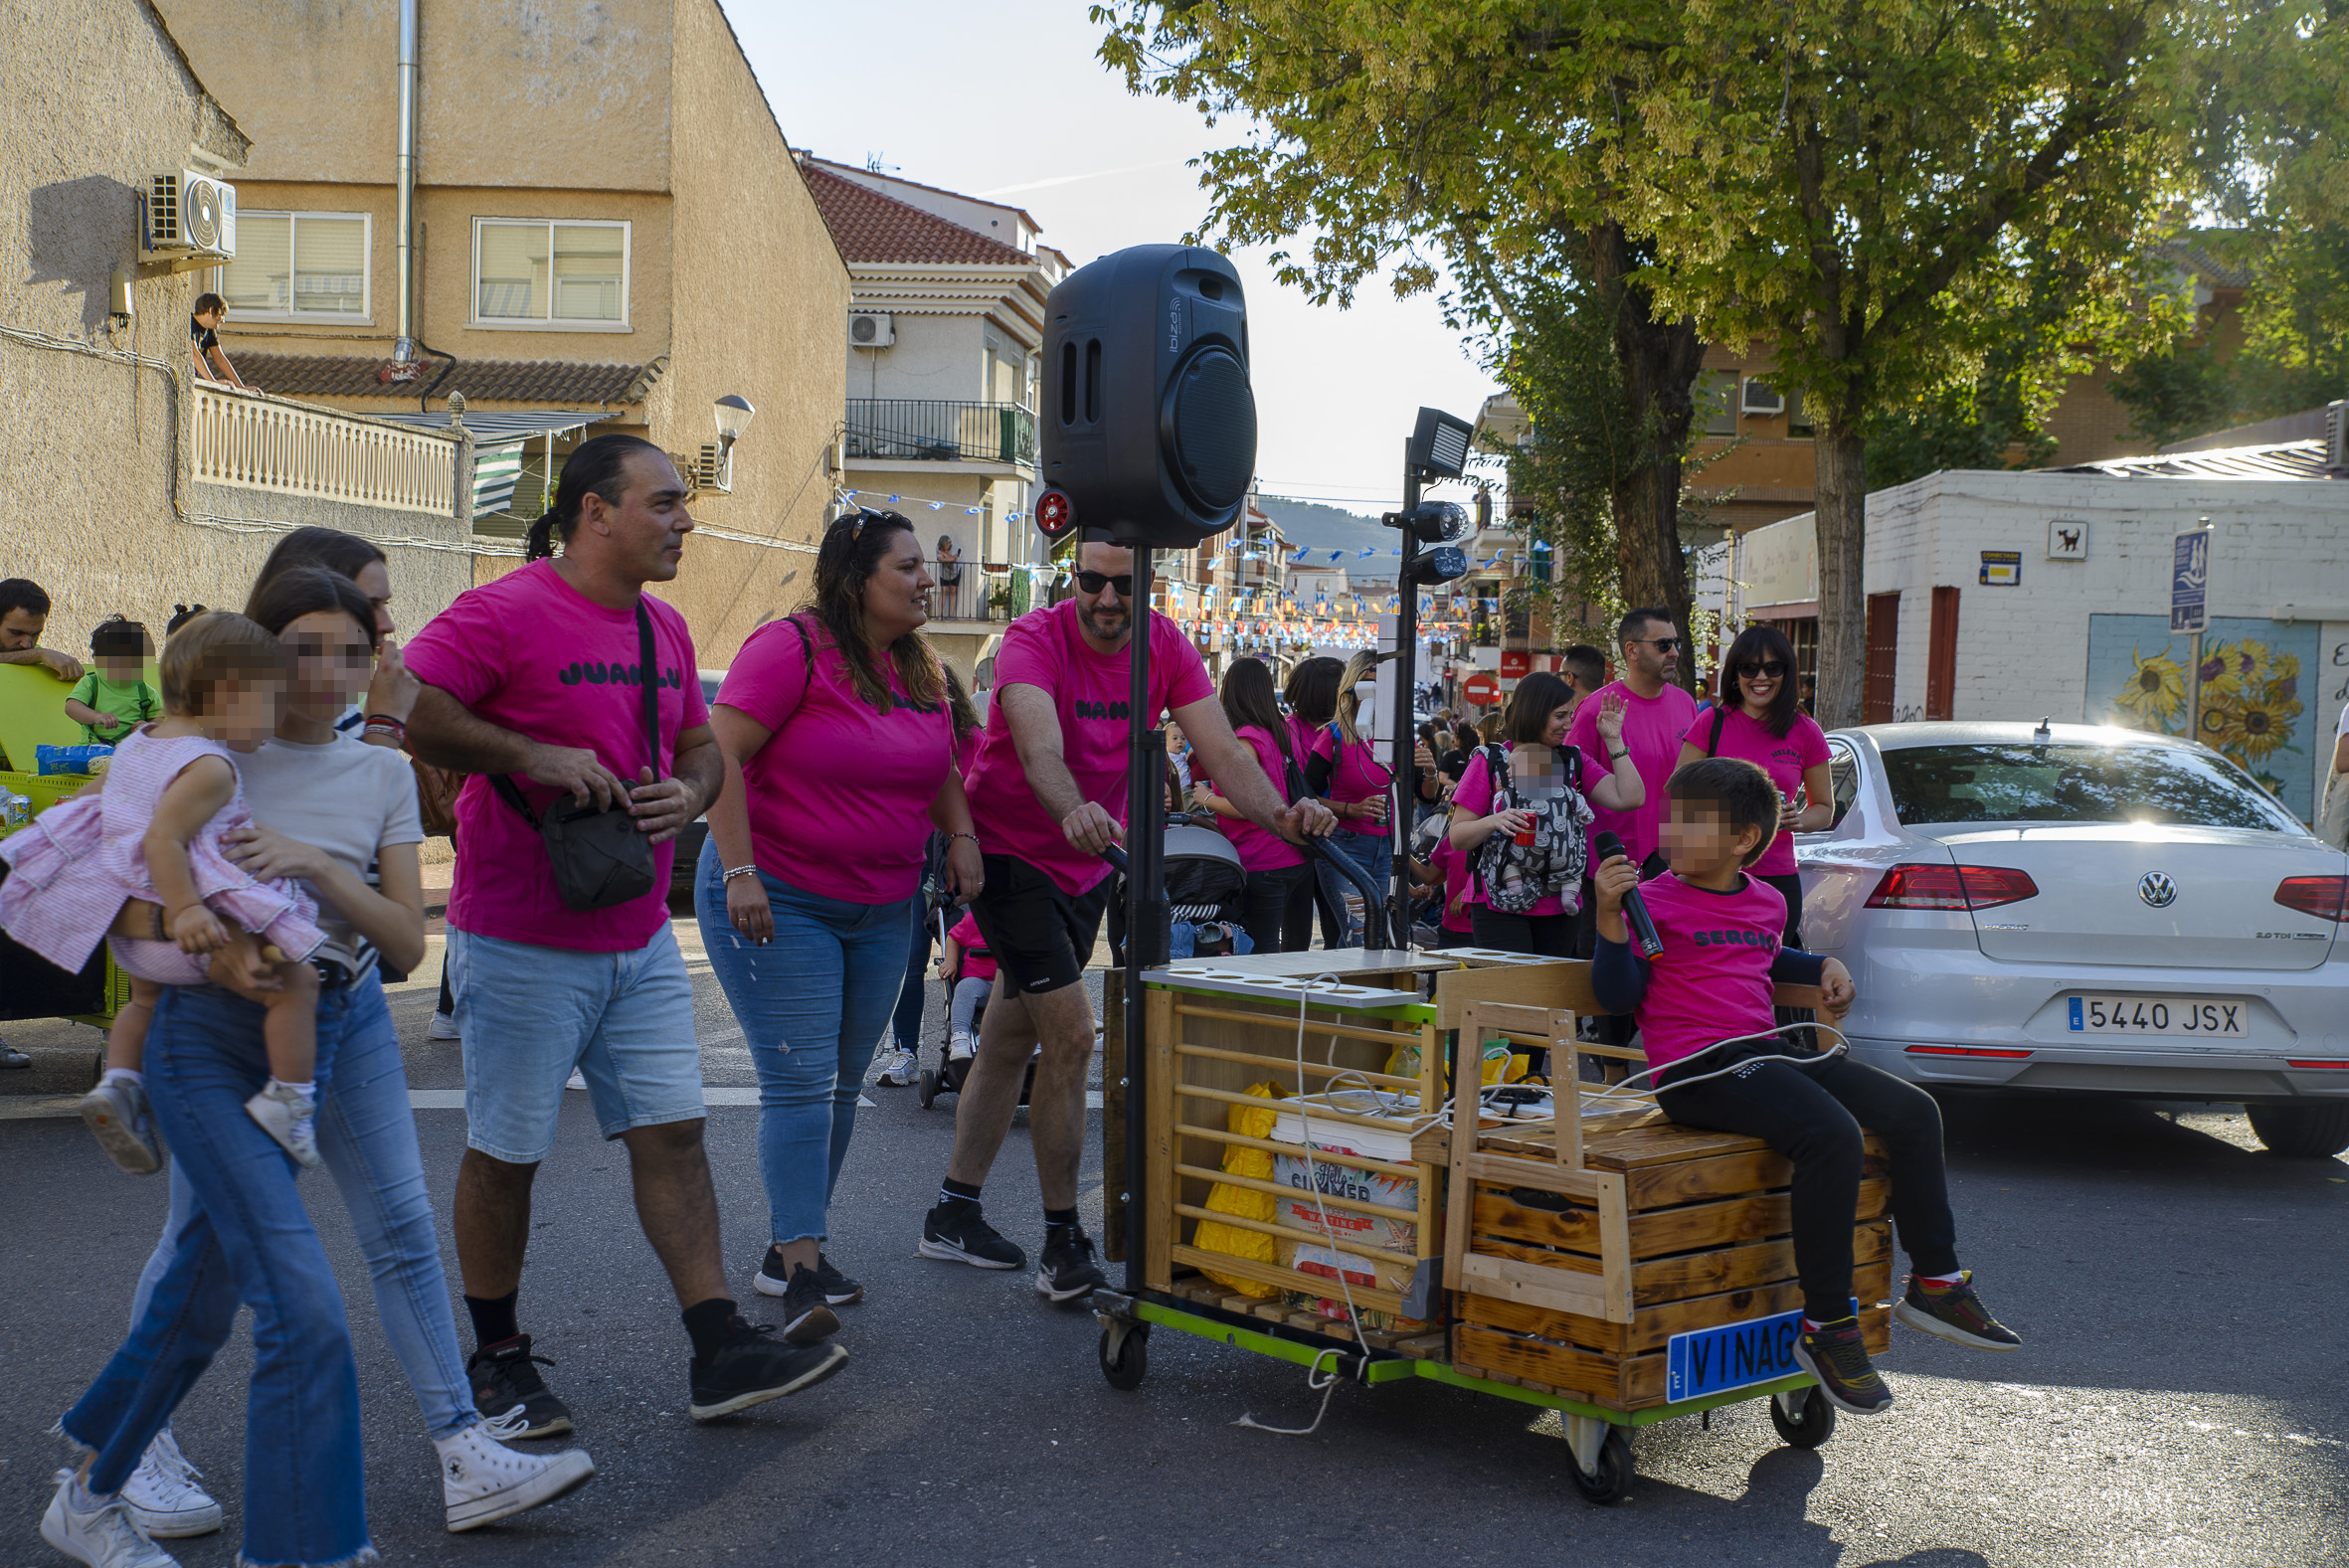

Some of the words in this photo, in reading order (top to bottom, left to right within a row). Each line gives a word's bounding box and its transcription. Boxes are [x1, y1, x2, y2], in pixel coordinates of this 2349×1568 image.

[1170, 311, 1178, 353] ibiza
[1075, 699, 1130, 721] MAN
[1770, 748, 1801, 763] HELENA
[1693, 930, 1775, 952] SERGIO
[2090, 1001, 2169, 1030] 5440
[2182, 1004, 2240, 1032] JSX
[1314, 1163, 1348, 1186] Hello
[1308, 1213, 1355, 1230] WATING
